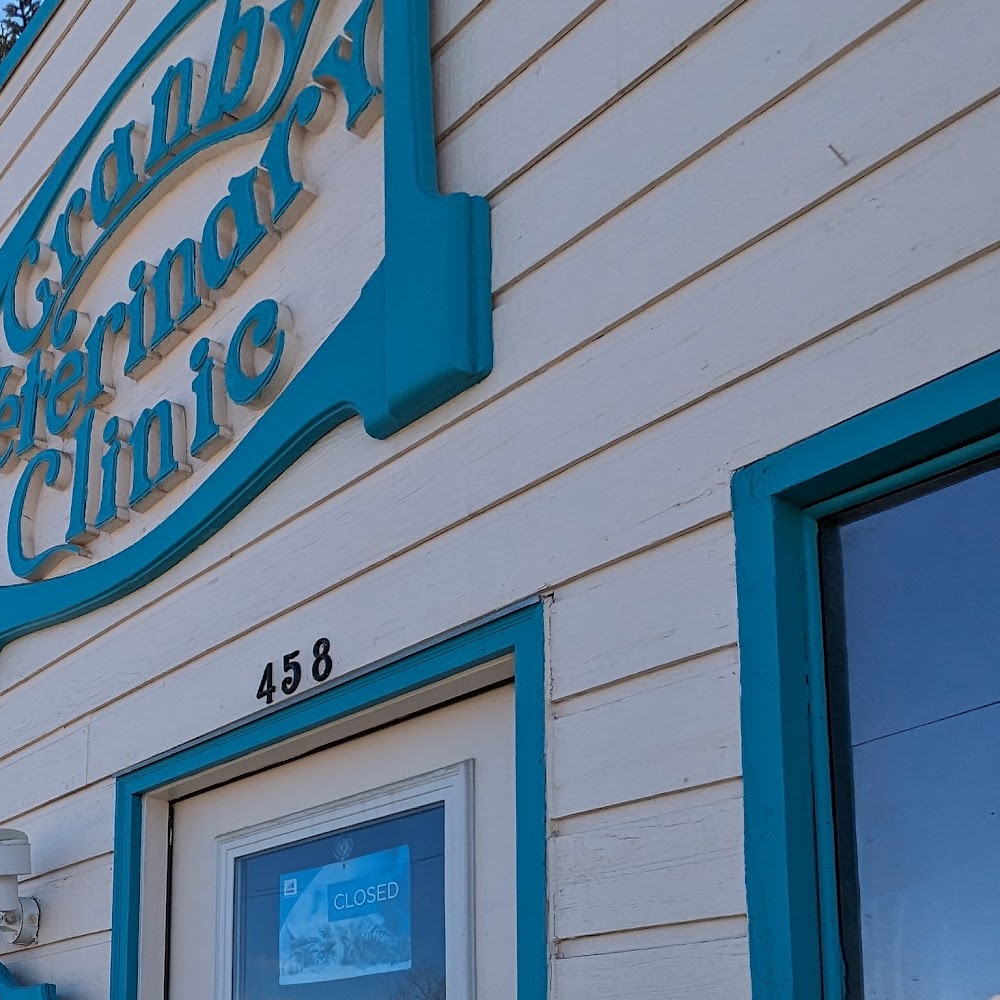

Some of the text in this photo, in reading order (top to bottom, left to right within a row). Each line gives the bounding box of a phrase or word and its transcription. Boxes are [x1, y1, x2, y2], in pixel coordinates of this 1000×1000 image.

[2, 0, 317, 355] Granby
[7, 299, 288, 578] Clinic
[256, 637, 333, 704] 458
[334, 881, 399, 910] CLOSED
